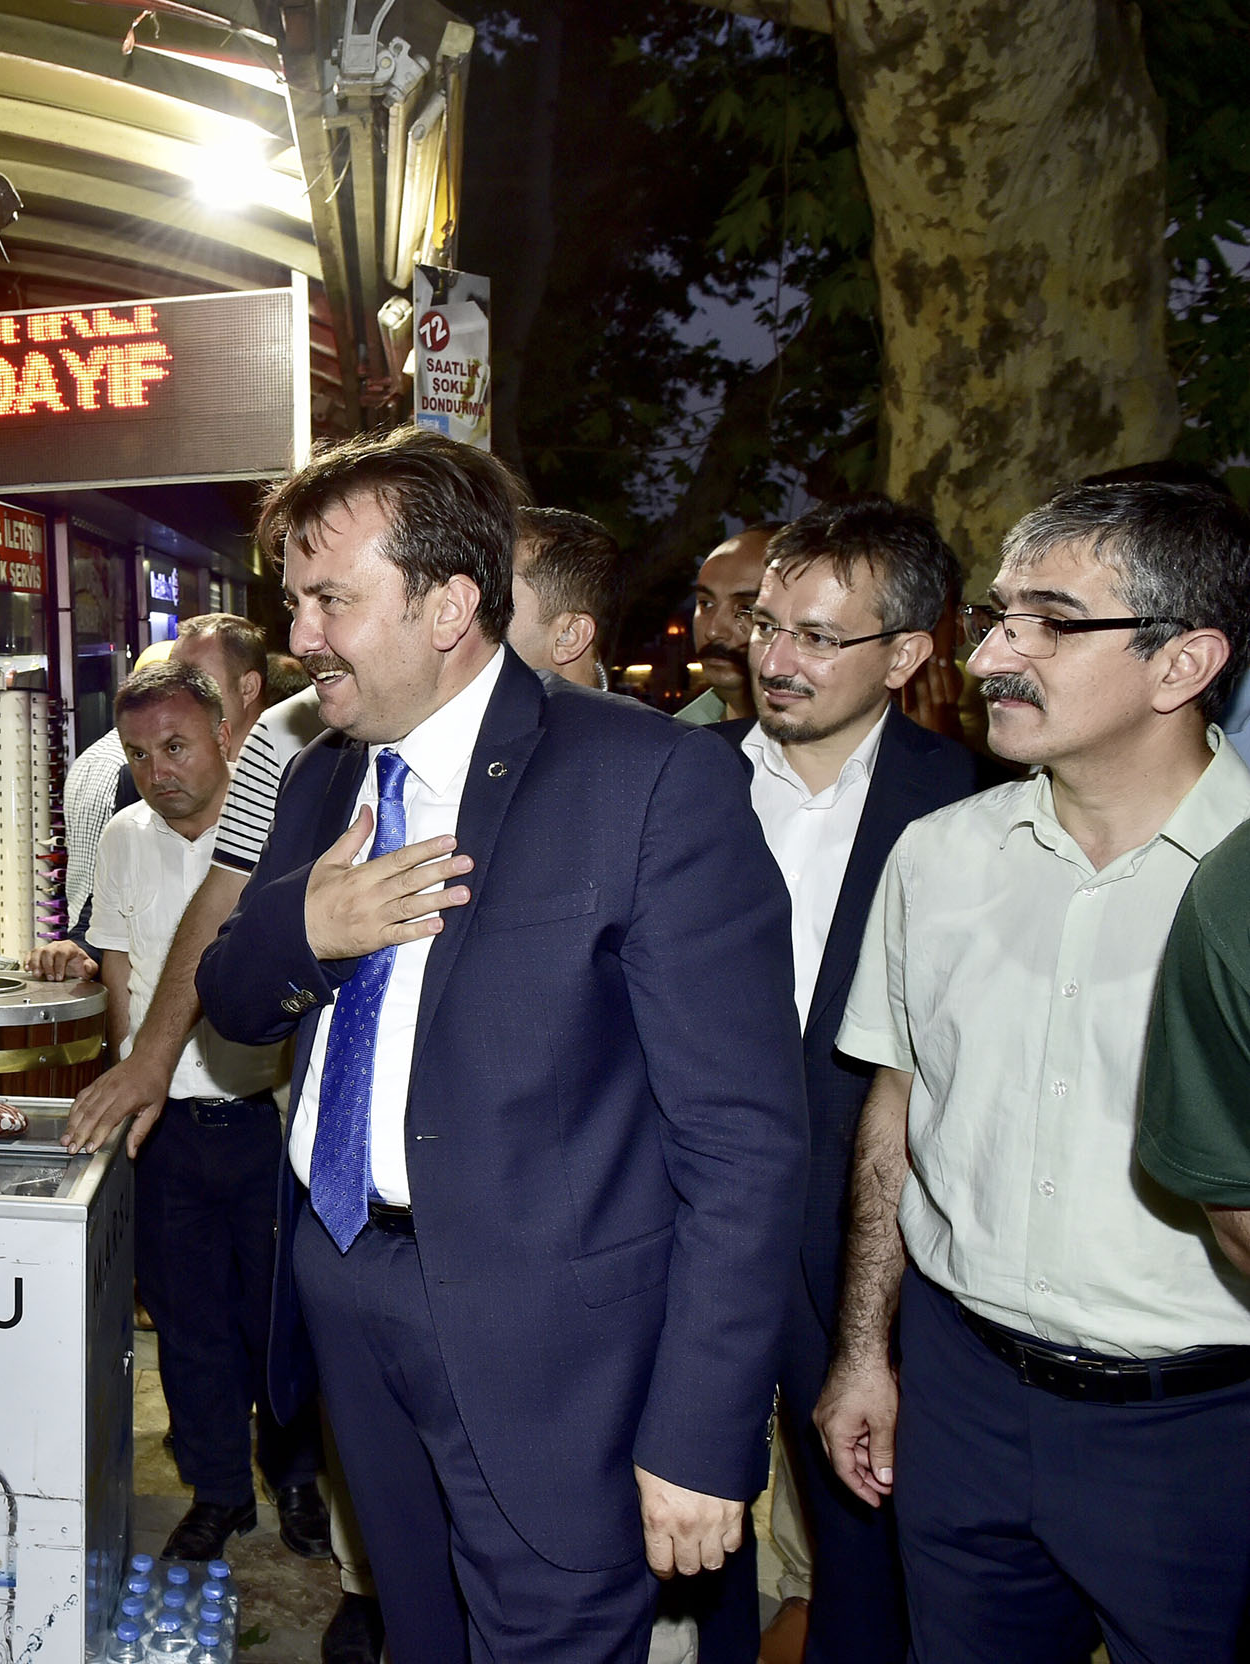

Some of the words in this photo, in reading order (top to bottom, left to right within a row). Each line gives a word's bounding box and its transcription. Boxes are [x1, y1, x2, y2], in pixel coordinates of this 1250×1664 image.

[419, 315, 447, 349] 72
[426, 357, 480, 379] SAATLİK
[421, 396, 485, 417] DONDURMA
[10, 559, 42, 590] SERVİS
